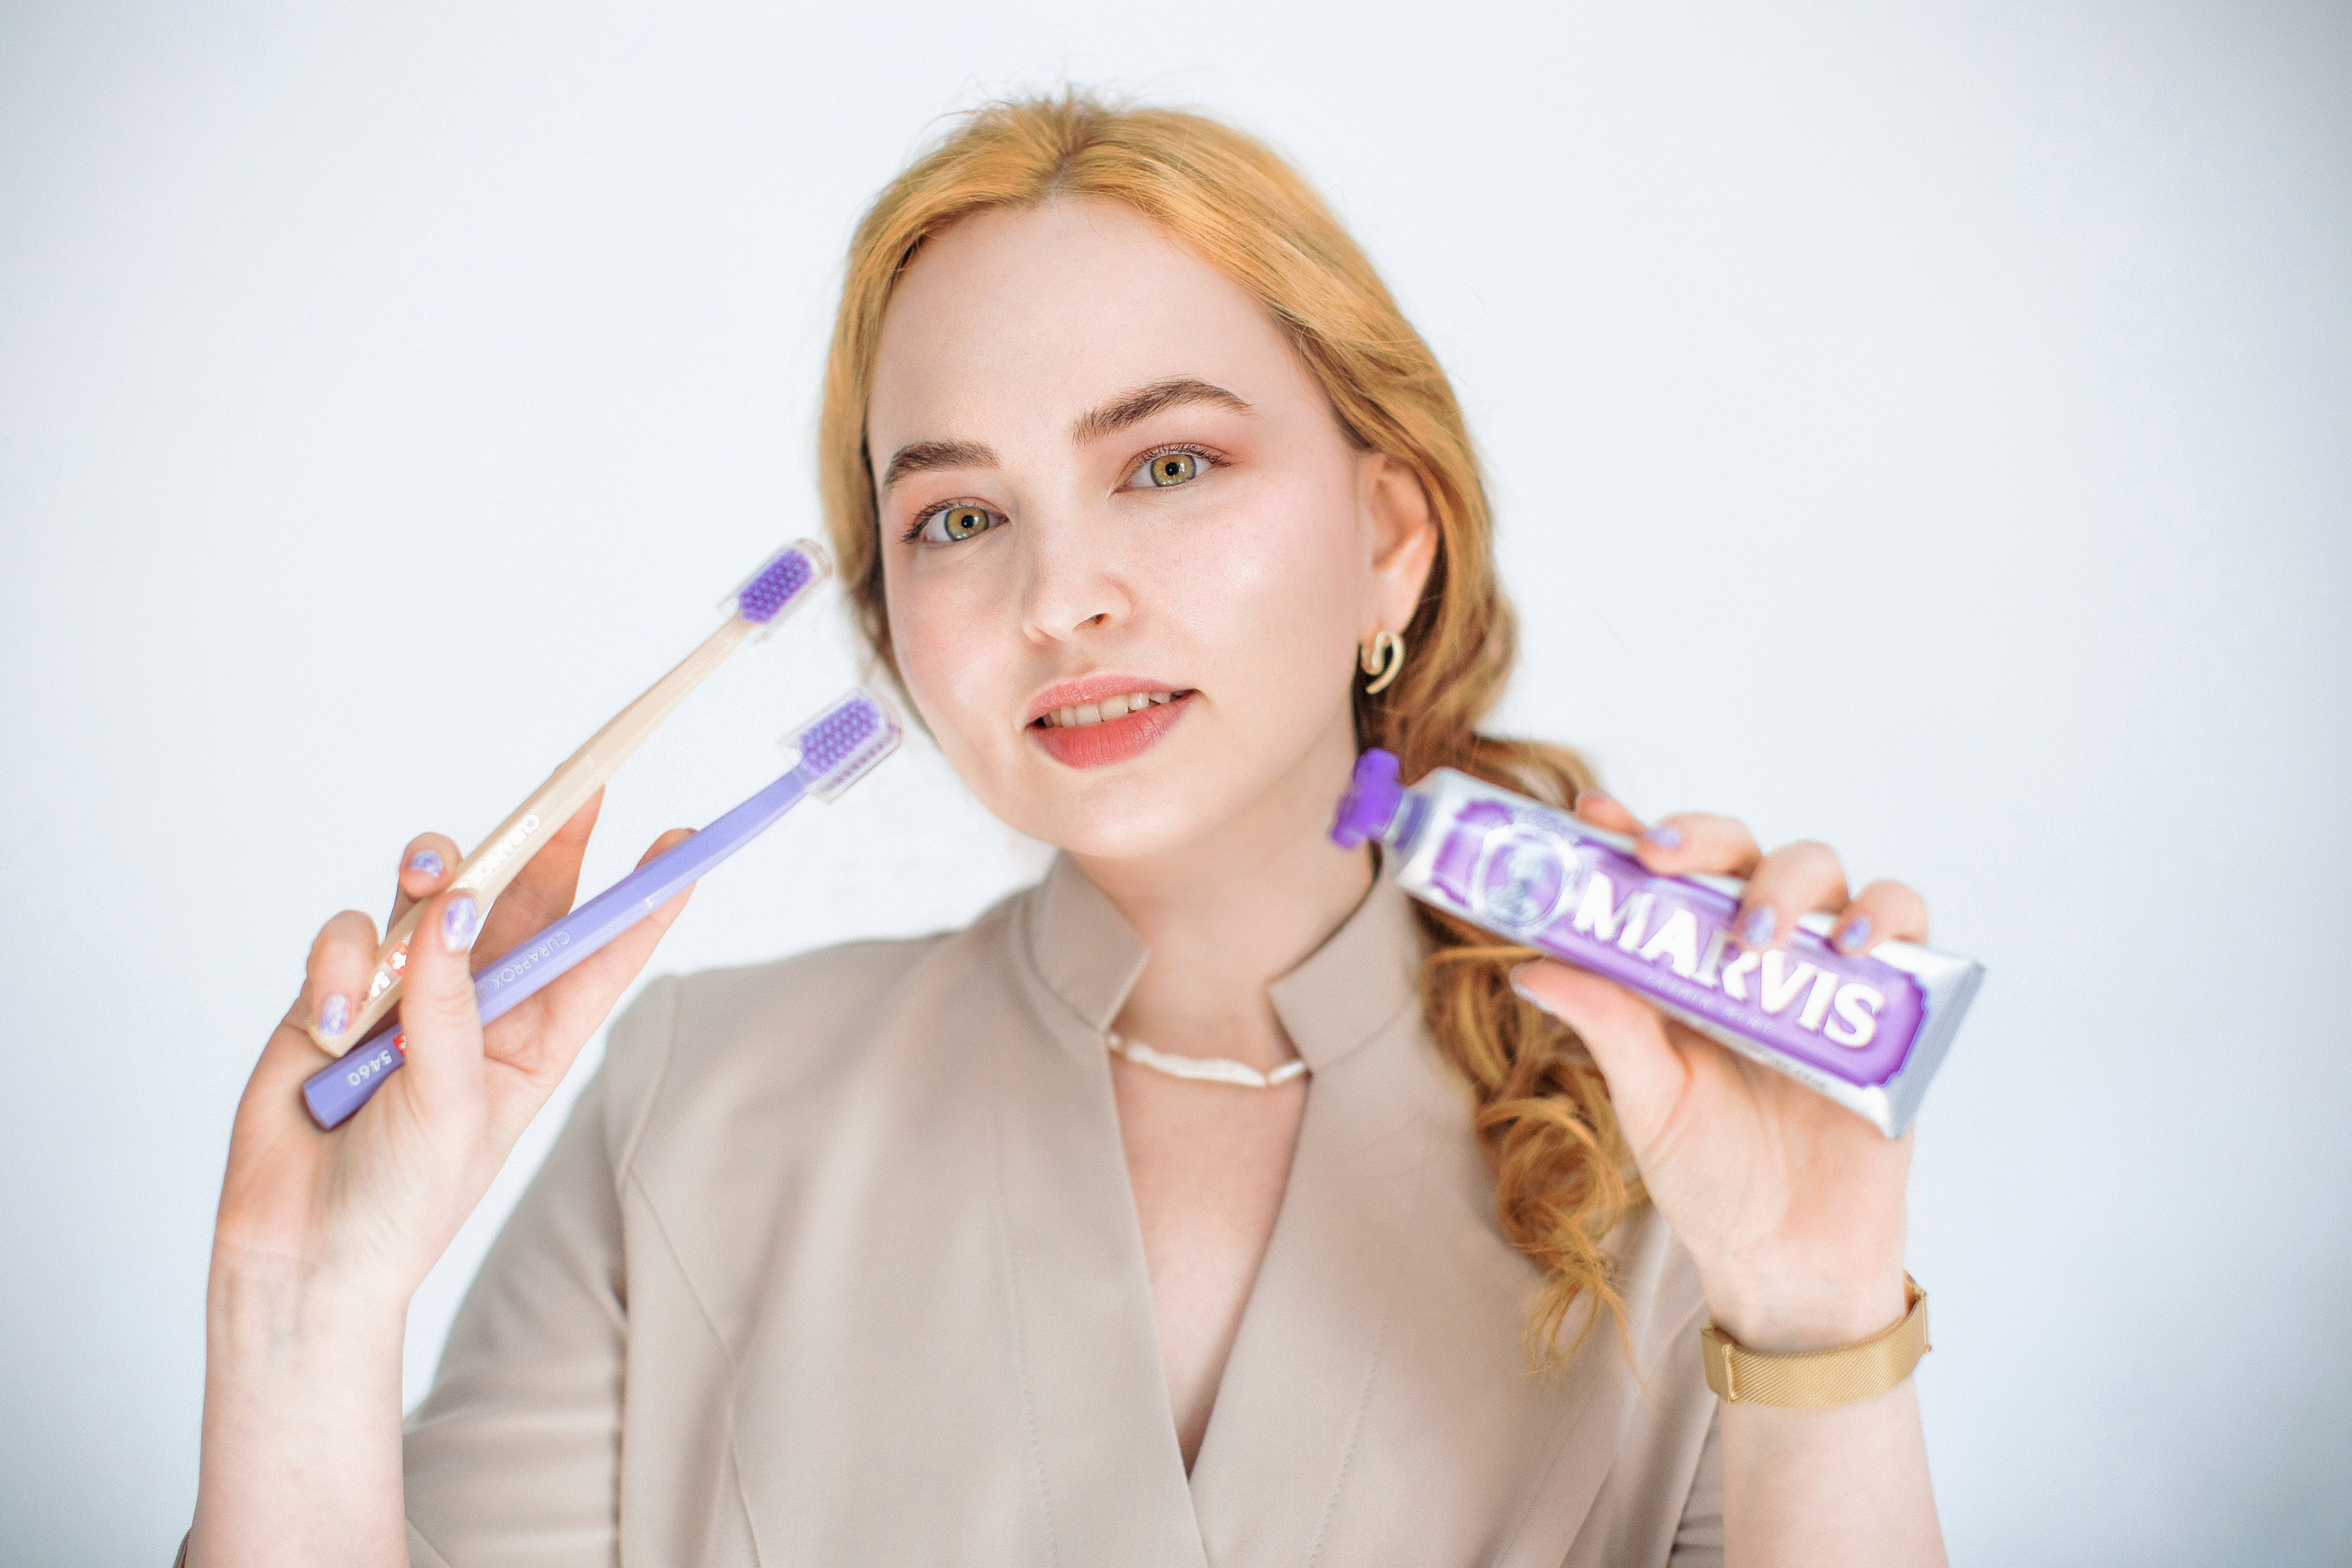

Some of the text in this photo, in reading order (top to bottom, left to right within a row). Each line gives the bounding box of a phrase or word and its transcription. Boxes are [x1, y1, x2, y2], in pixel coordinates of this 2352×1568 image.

[492, 930, 571, 989] CURAPROX
[1572, 870, 1884, 1048] MARVIS
[347, 1049, 392, 1086] 5460
